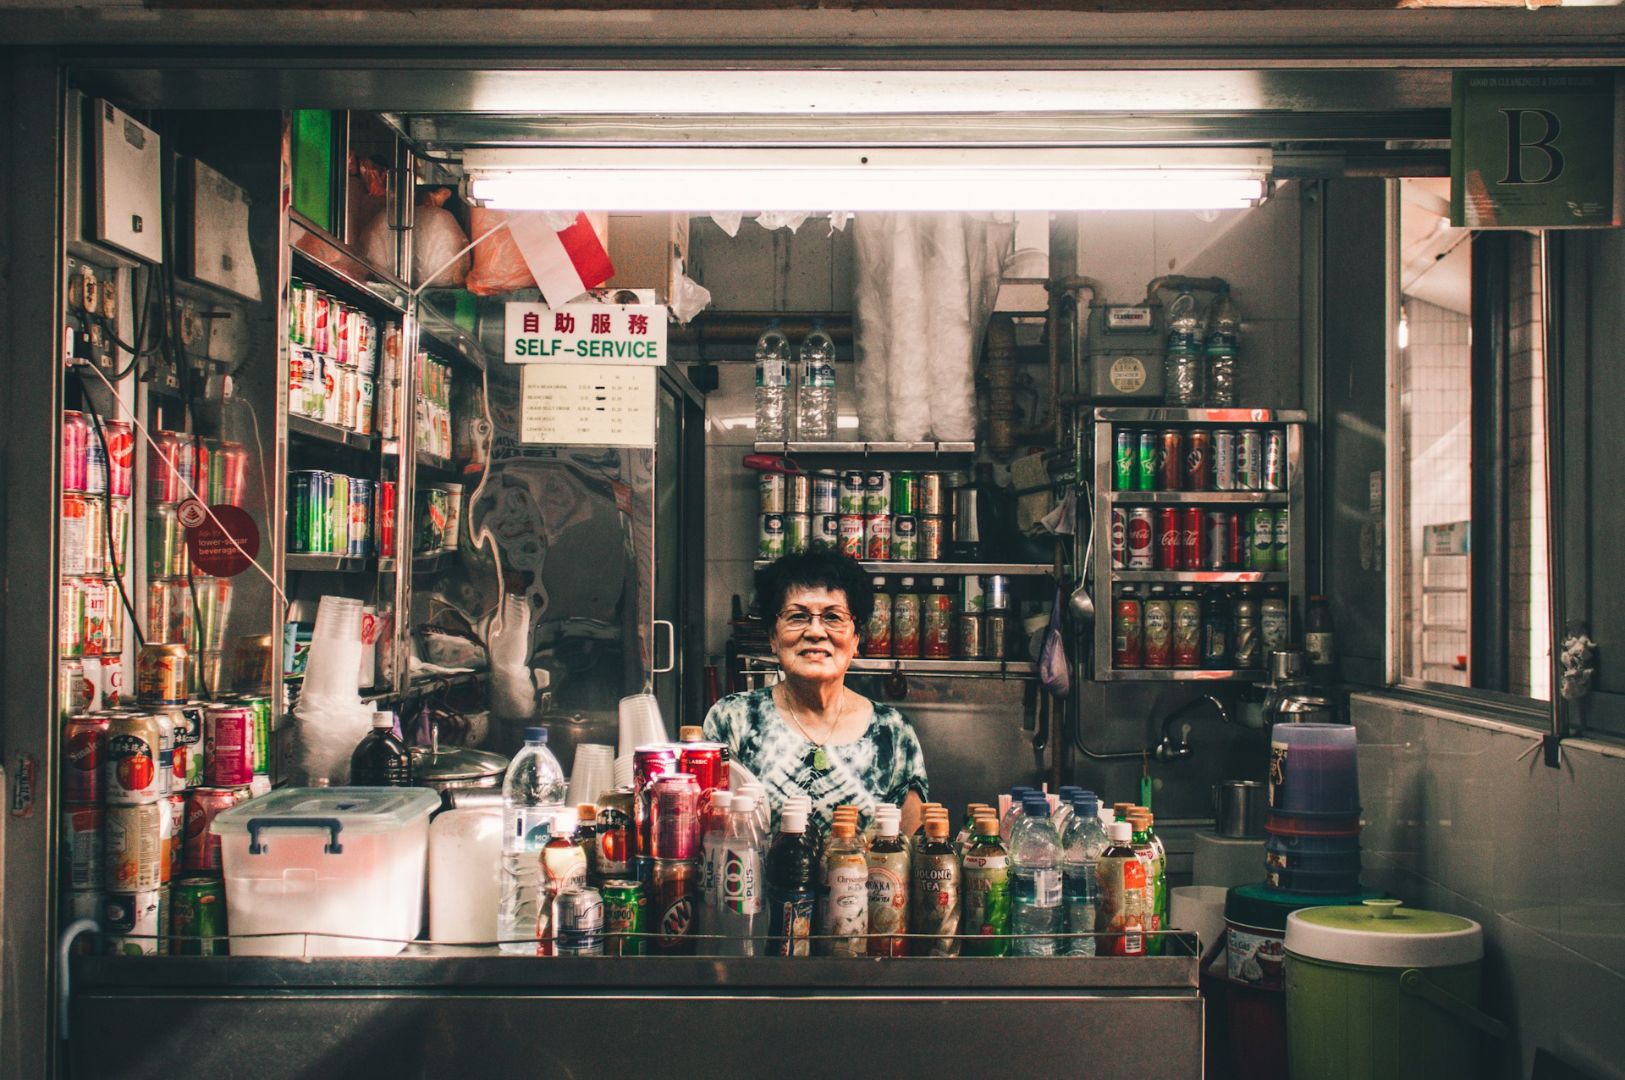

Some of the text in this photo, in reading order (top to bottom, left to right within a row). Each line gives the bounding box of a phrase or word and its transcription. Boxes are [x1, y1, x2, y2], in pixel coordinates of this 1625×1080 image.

[1496, 107, 1566, 186] B
[523, 312, 649, 335] 自助服務
[515, 339, 658, 359] SELF-SERVICE
[687, 758, 709, 766] CLASSIC
[725, 860, 745, 902] 100
[745, 867, 754, 900] PLUS
[914, 868, 952, 881] OOLONG
[921, 879, 940, 892] TEA
